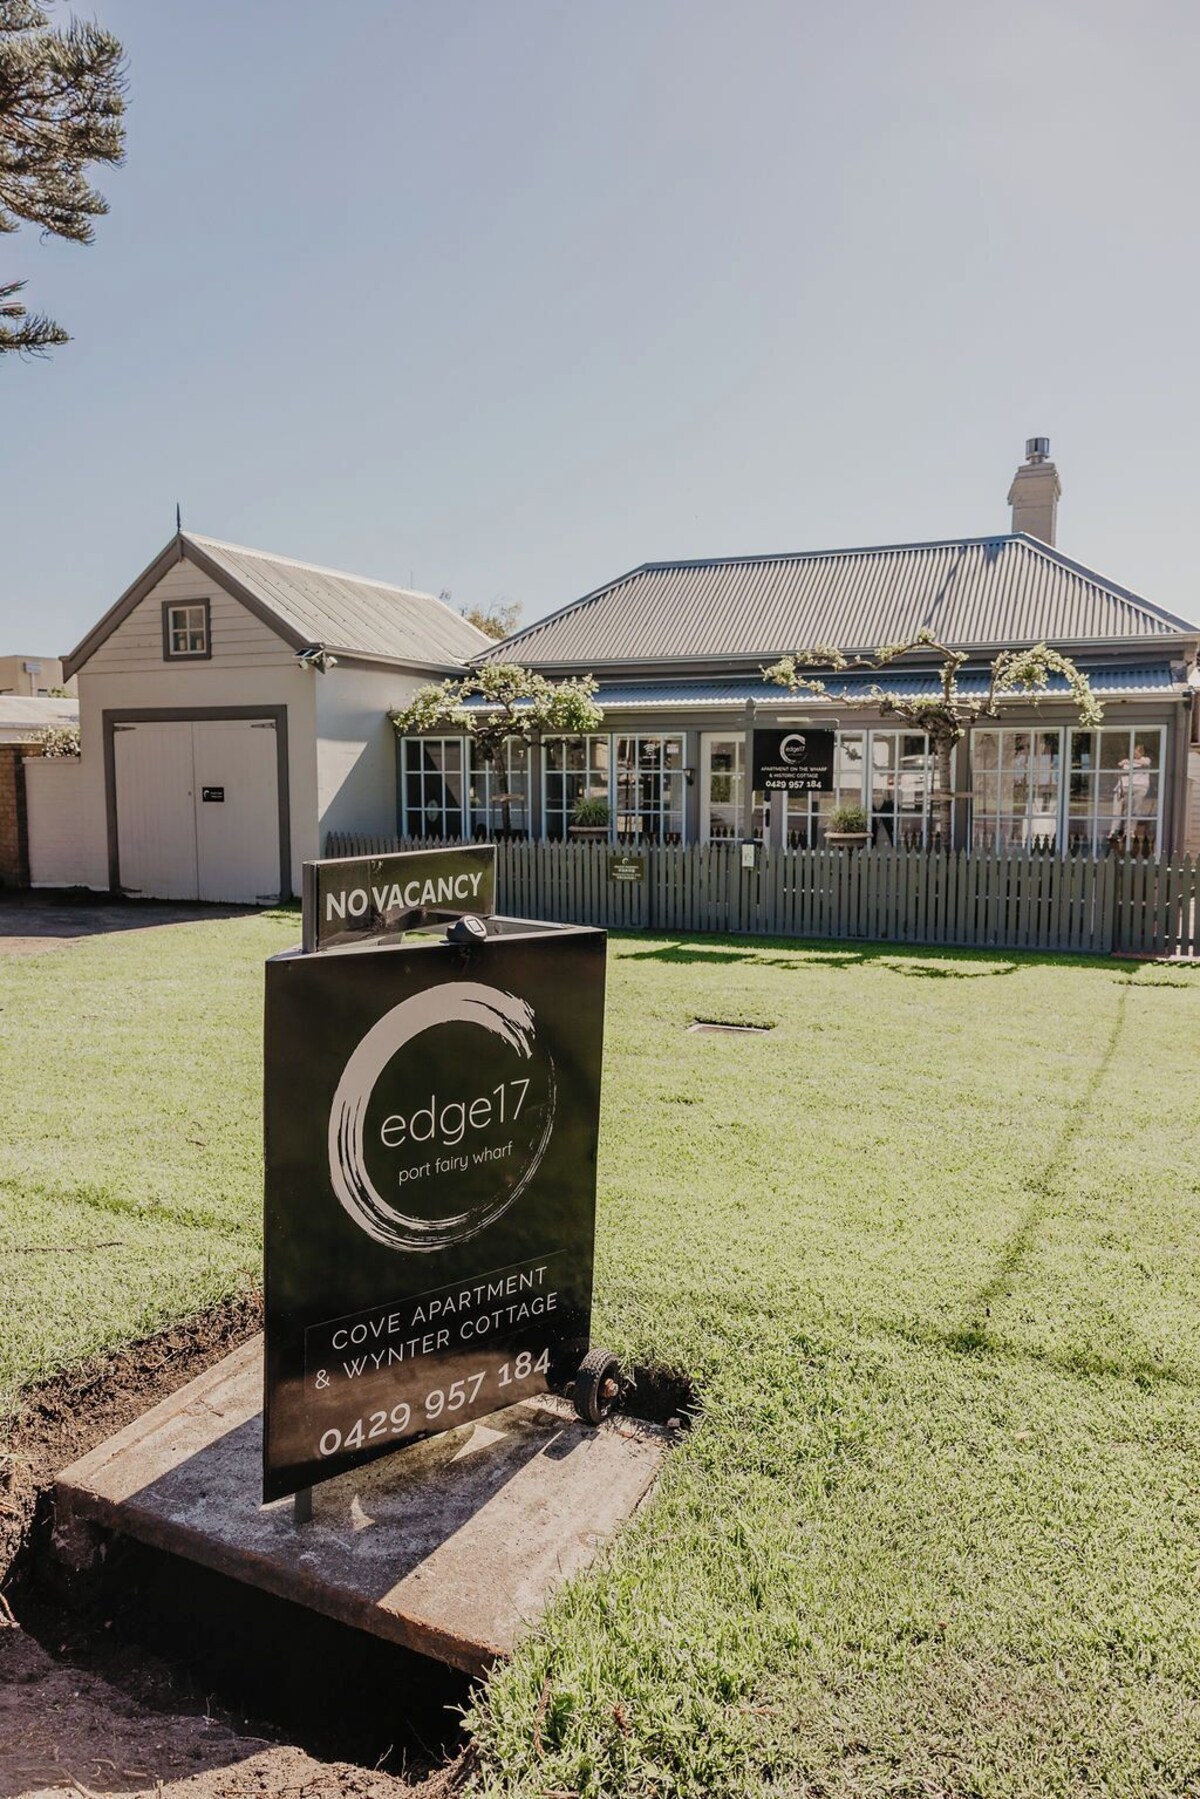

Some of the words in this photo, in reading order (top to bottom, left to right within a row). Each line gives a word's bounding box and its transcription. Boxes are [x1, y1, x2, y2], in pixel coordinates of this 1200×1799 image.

[765, 780, 787, 788] 0429
[788, 780, 804, 788] 957
[806, 780, 822, 788] 184
[326, 889, 368, 921] NO
[371, 872, 483, 912] VACANCY
[380, 1078, 531, 1147] edge17
[398, 1162, 431, 1186] port
[435, 1154, 469, 1174] fairy
[472, 1140, 513, 1165] wharf
[314, 1369, 331, 1390] &
[342, 1329, 450, 1379] WYNTER
[459, 1292, 558, 1340] COTTAGE
[332, 1312, 401, 1350] COVE
[411, 1266, 548, 1326] APARTMENT
[319, 1403, 411, 1456] 0429
[424, 1371, 486, 1420] 957
[498, 1348, 551, 1388] 184
